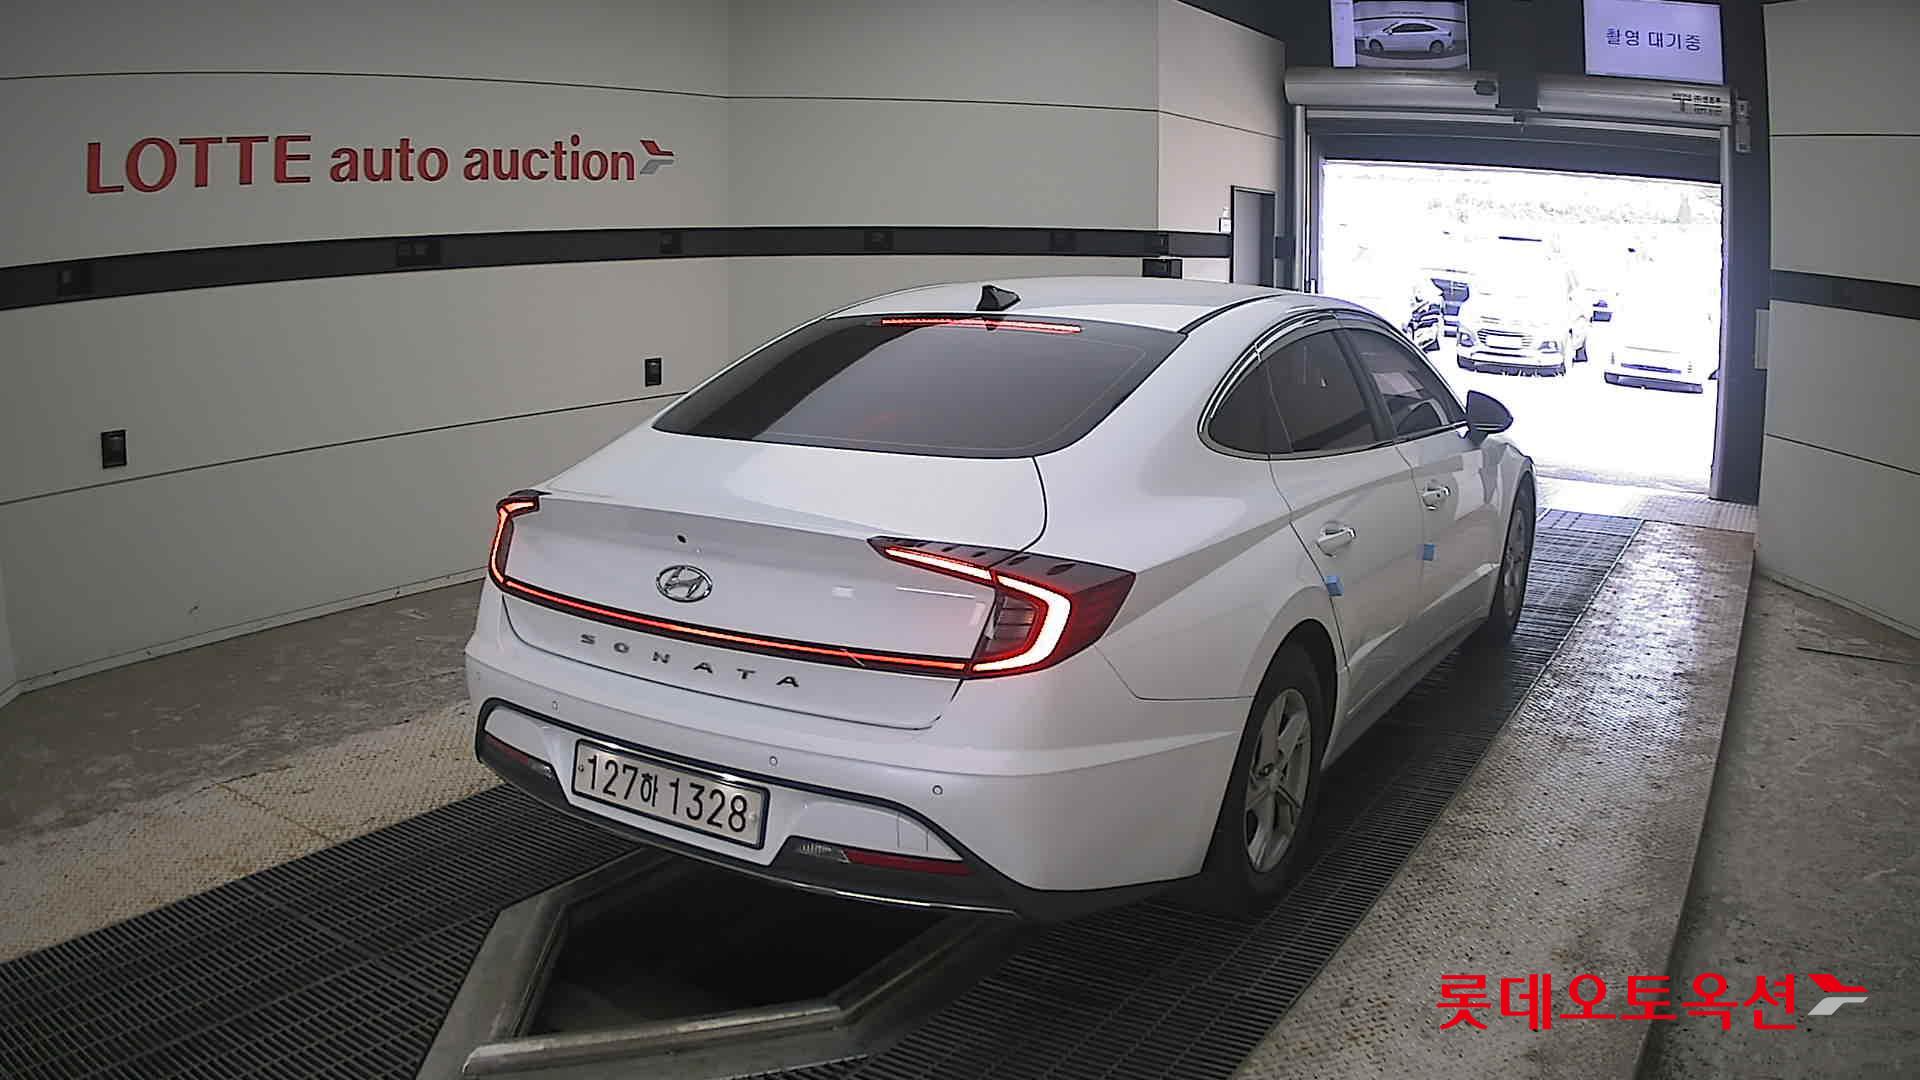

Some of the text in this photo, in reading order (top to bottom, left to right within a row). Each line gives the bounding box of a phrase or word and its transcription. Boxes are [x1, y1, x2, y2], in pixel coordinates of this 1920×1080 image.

[1606, 28, 1701, 51] 촬영 대기중
[86, 134, 635, 194] LOTTE auto auction
[580, 633, 799, 688] SONATA
[669, 777, 748, 833] 1328
